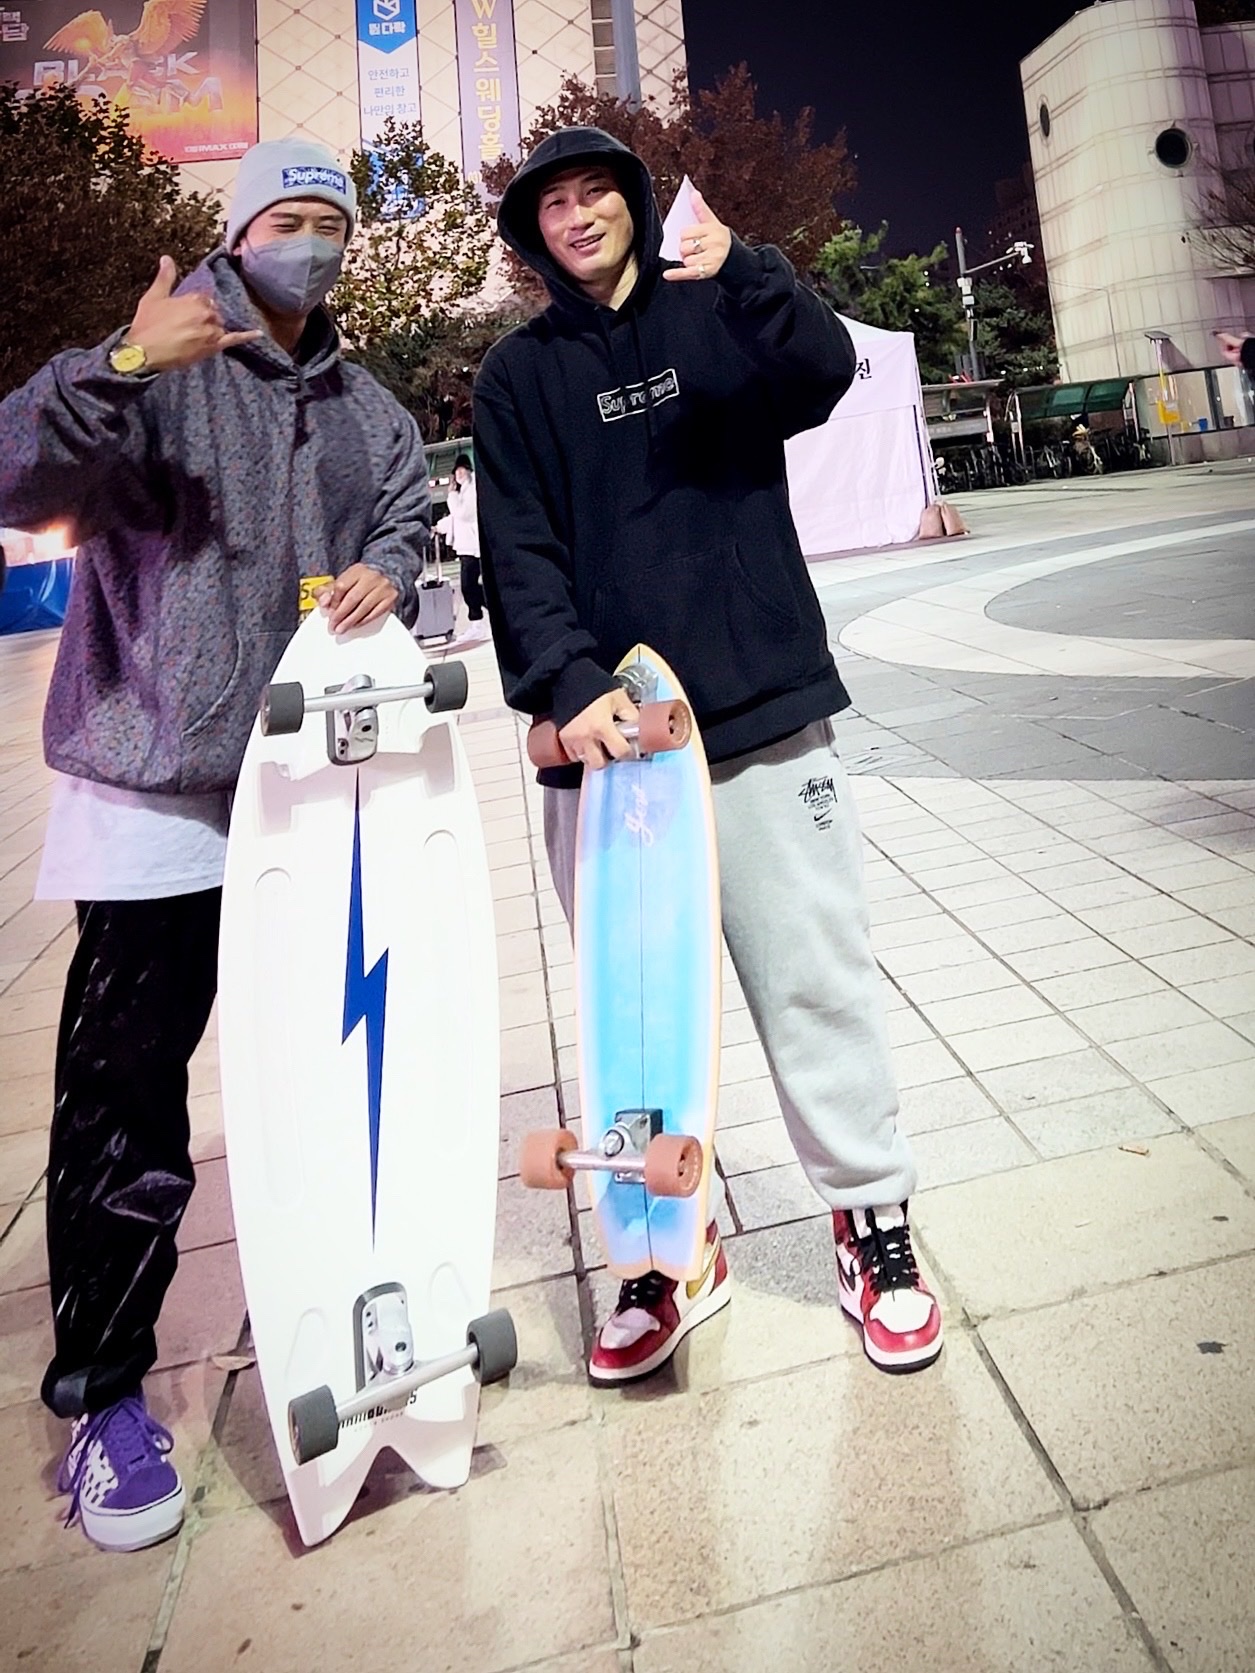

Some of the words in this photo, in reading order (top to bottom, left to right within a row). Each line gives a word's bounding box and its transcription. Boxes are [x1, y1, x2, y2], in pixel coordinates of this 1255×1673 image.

[368, 68, 410, 80] 안전하고
[374, 85, 406, 98] 편리한
[363, 104, 395, 116] 나만의
[396, 102, 417, 114] 창고
